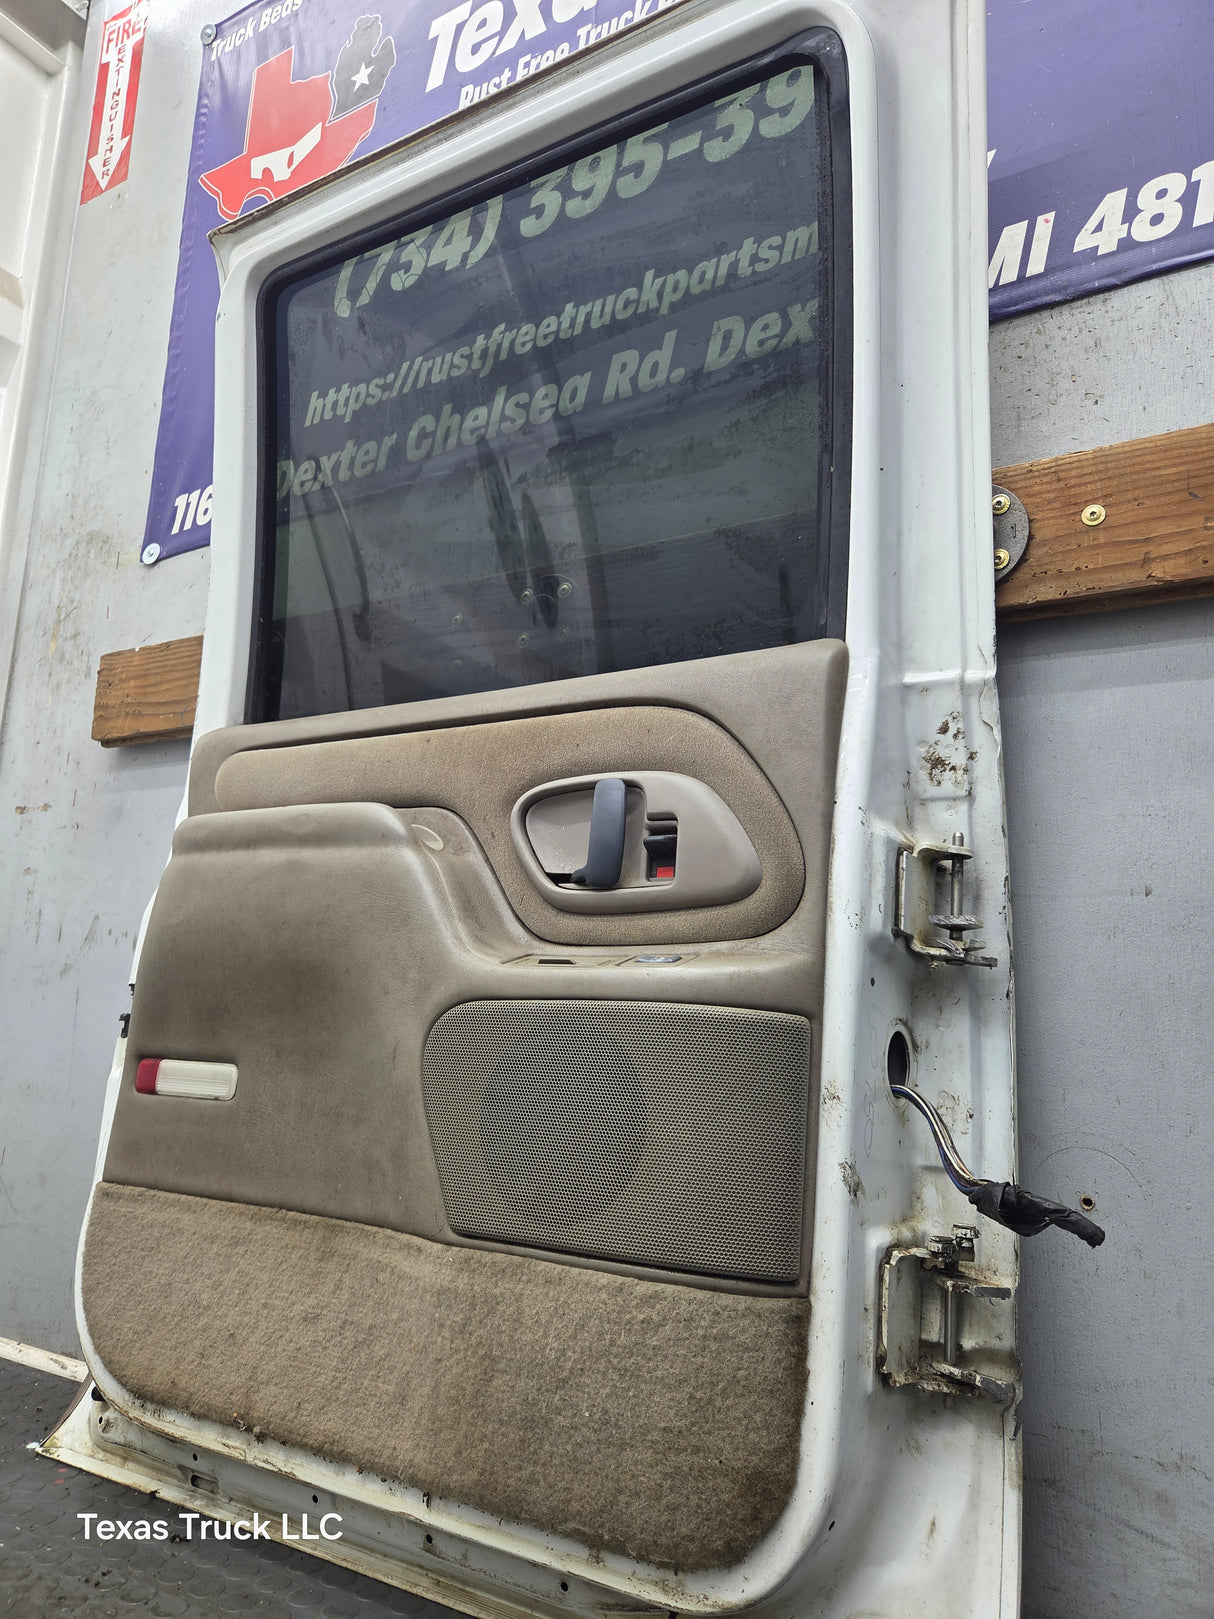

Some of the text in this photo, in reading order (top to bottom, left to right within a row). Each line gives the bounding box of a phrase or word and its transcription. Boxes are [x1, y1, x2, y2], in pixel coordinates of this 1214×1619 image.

[105, 18, 142, 55] FIRE
[210, 17, 257, 61] Truck
[101, 44, 127, 180] EXTINGUISHER
[334, 195, 504, 318] (734)
[170, 484, 213, 535] 116
[276, 433, 397, 500] Dexter
[406, 371, 592, 462] Chelsea
[602, 329, 686, 405] Rd.
[703, 297, 819, 374] Dex
